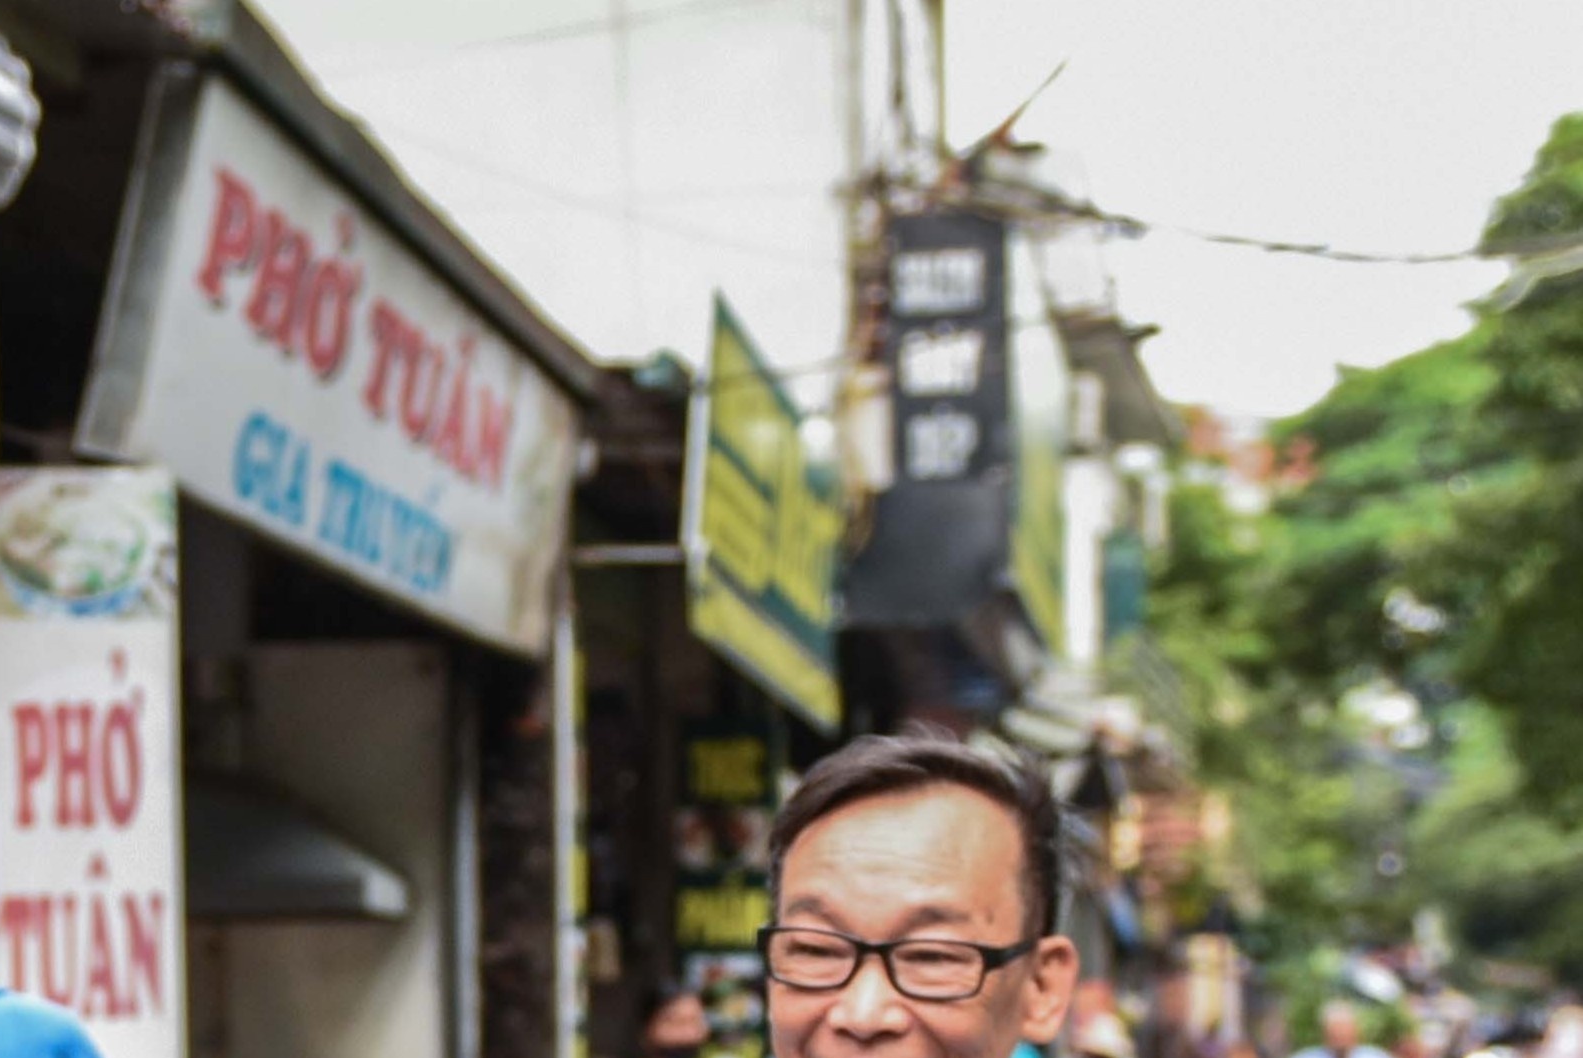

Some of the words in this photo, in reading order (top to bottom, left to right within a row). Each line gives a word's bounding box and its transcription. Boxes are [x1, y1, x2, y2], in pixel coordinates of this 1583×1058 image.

[195, 167, 363, 379] PHỞ
[232, 409, 310, 526] GIA
[10, 645, 146, 831] PHỞ
